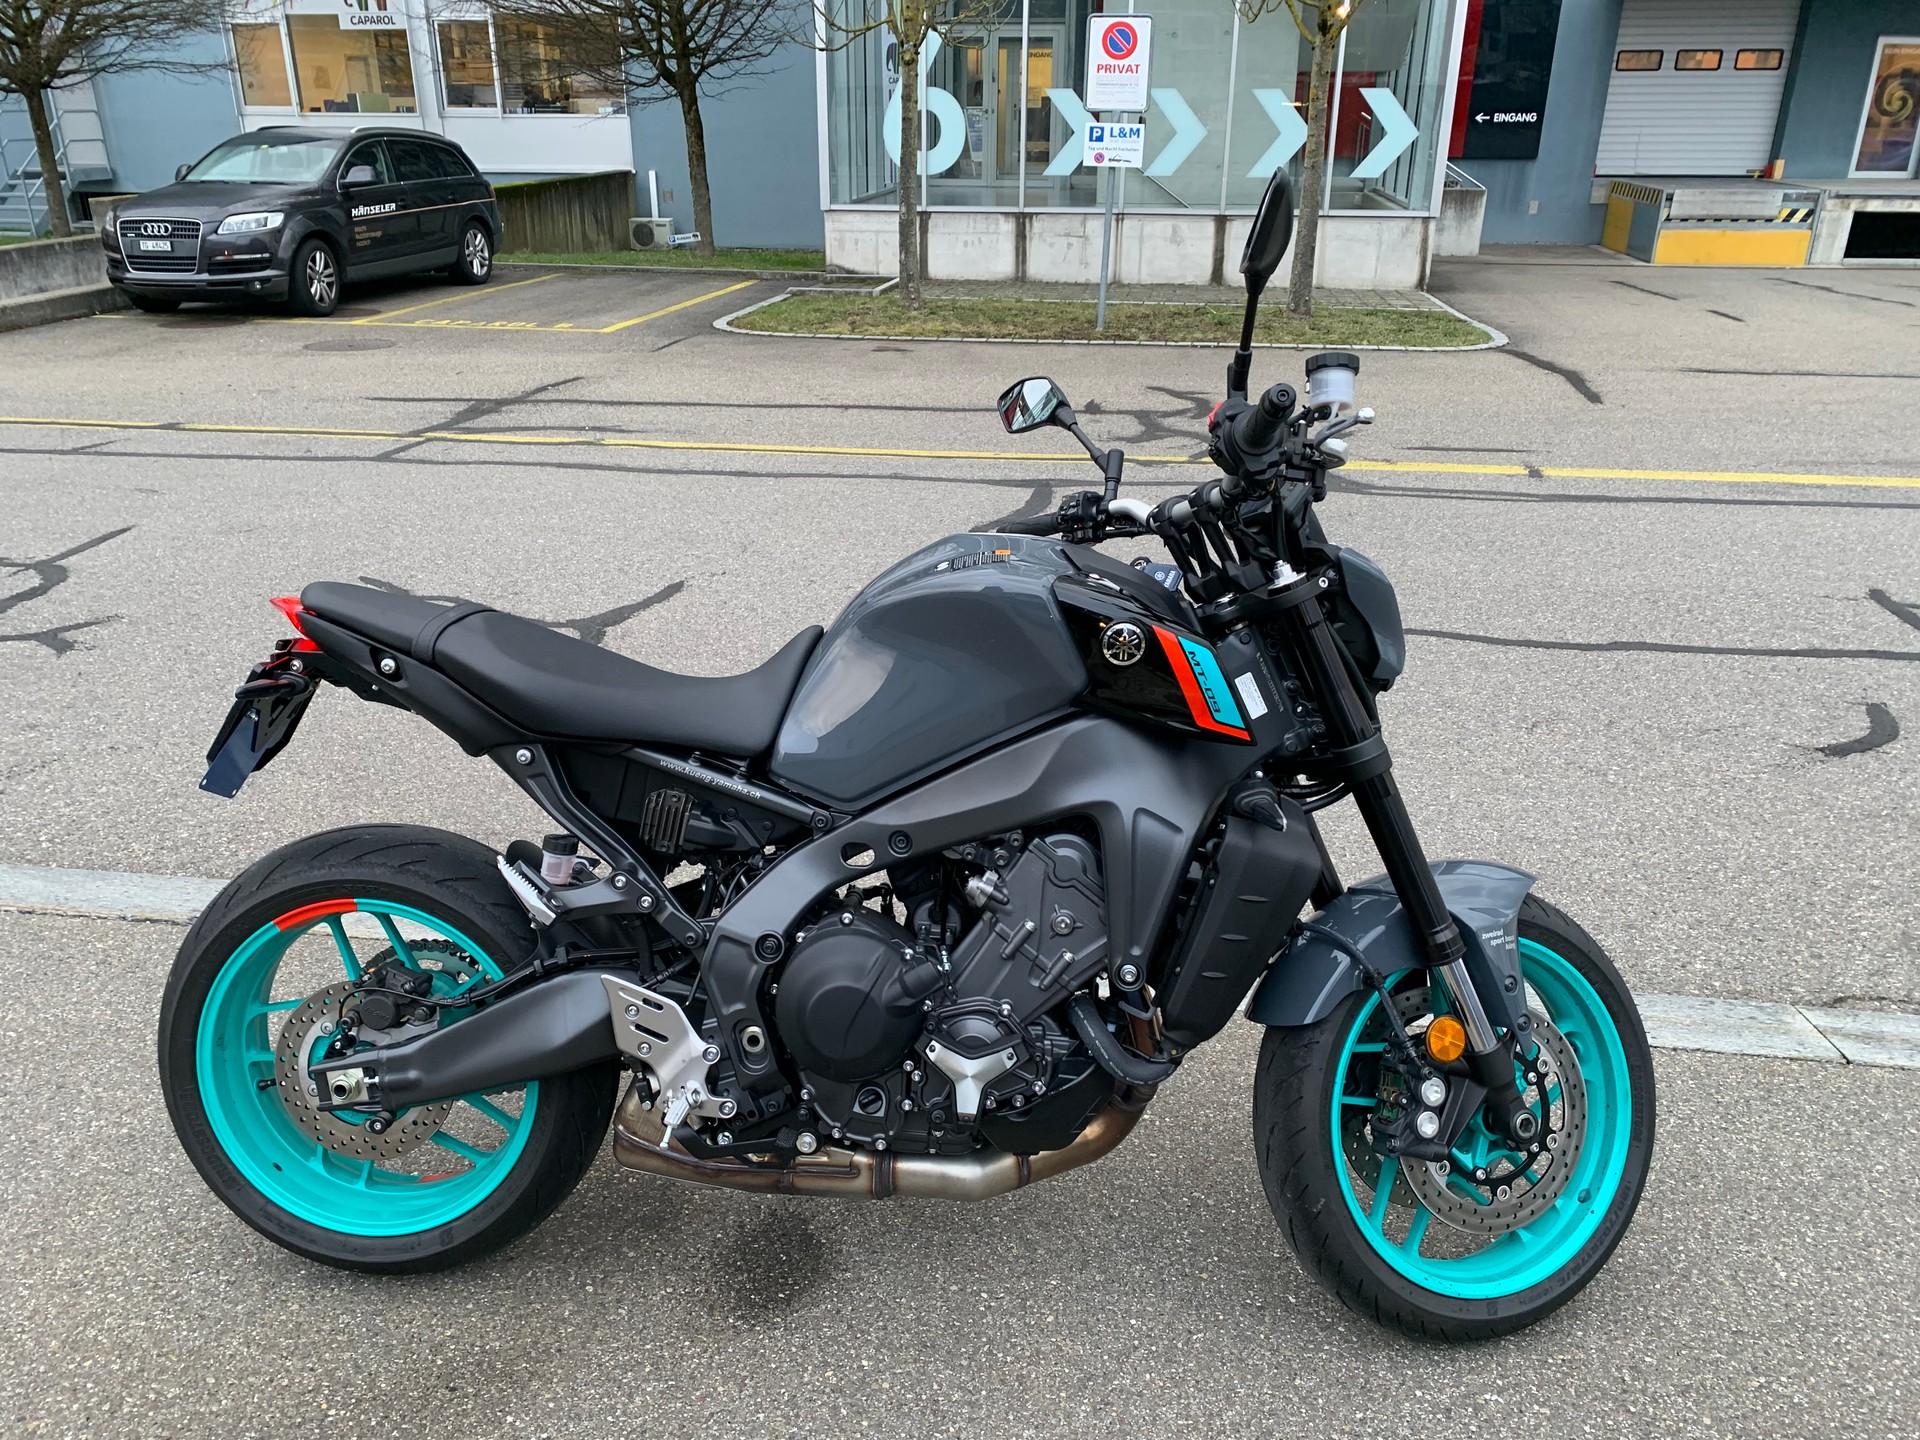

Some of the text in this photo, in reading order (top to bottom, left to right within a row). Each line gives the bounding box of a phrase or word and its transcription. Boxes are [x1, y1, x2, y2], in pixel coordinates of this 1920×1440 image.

[350, 15, 396, 25] CAPAROL
[1096, 63, 1141, 74] PRIVAT
[1493, 112, 1538, 123] EINGANG
[1109, 126, 1141, 139] L&M
[351, 202, 396, 217] HÄNSELER
[1188, 651, 1221, 712] MT-09
